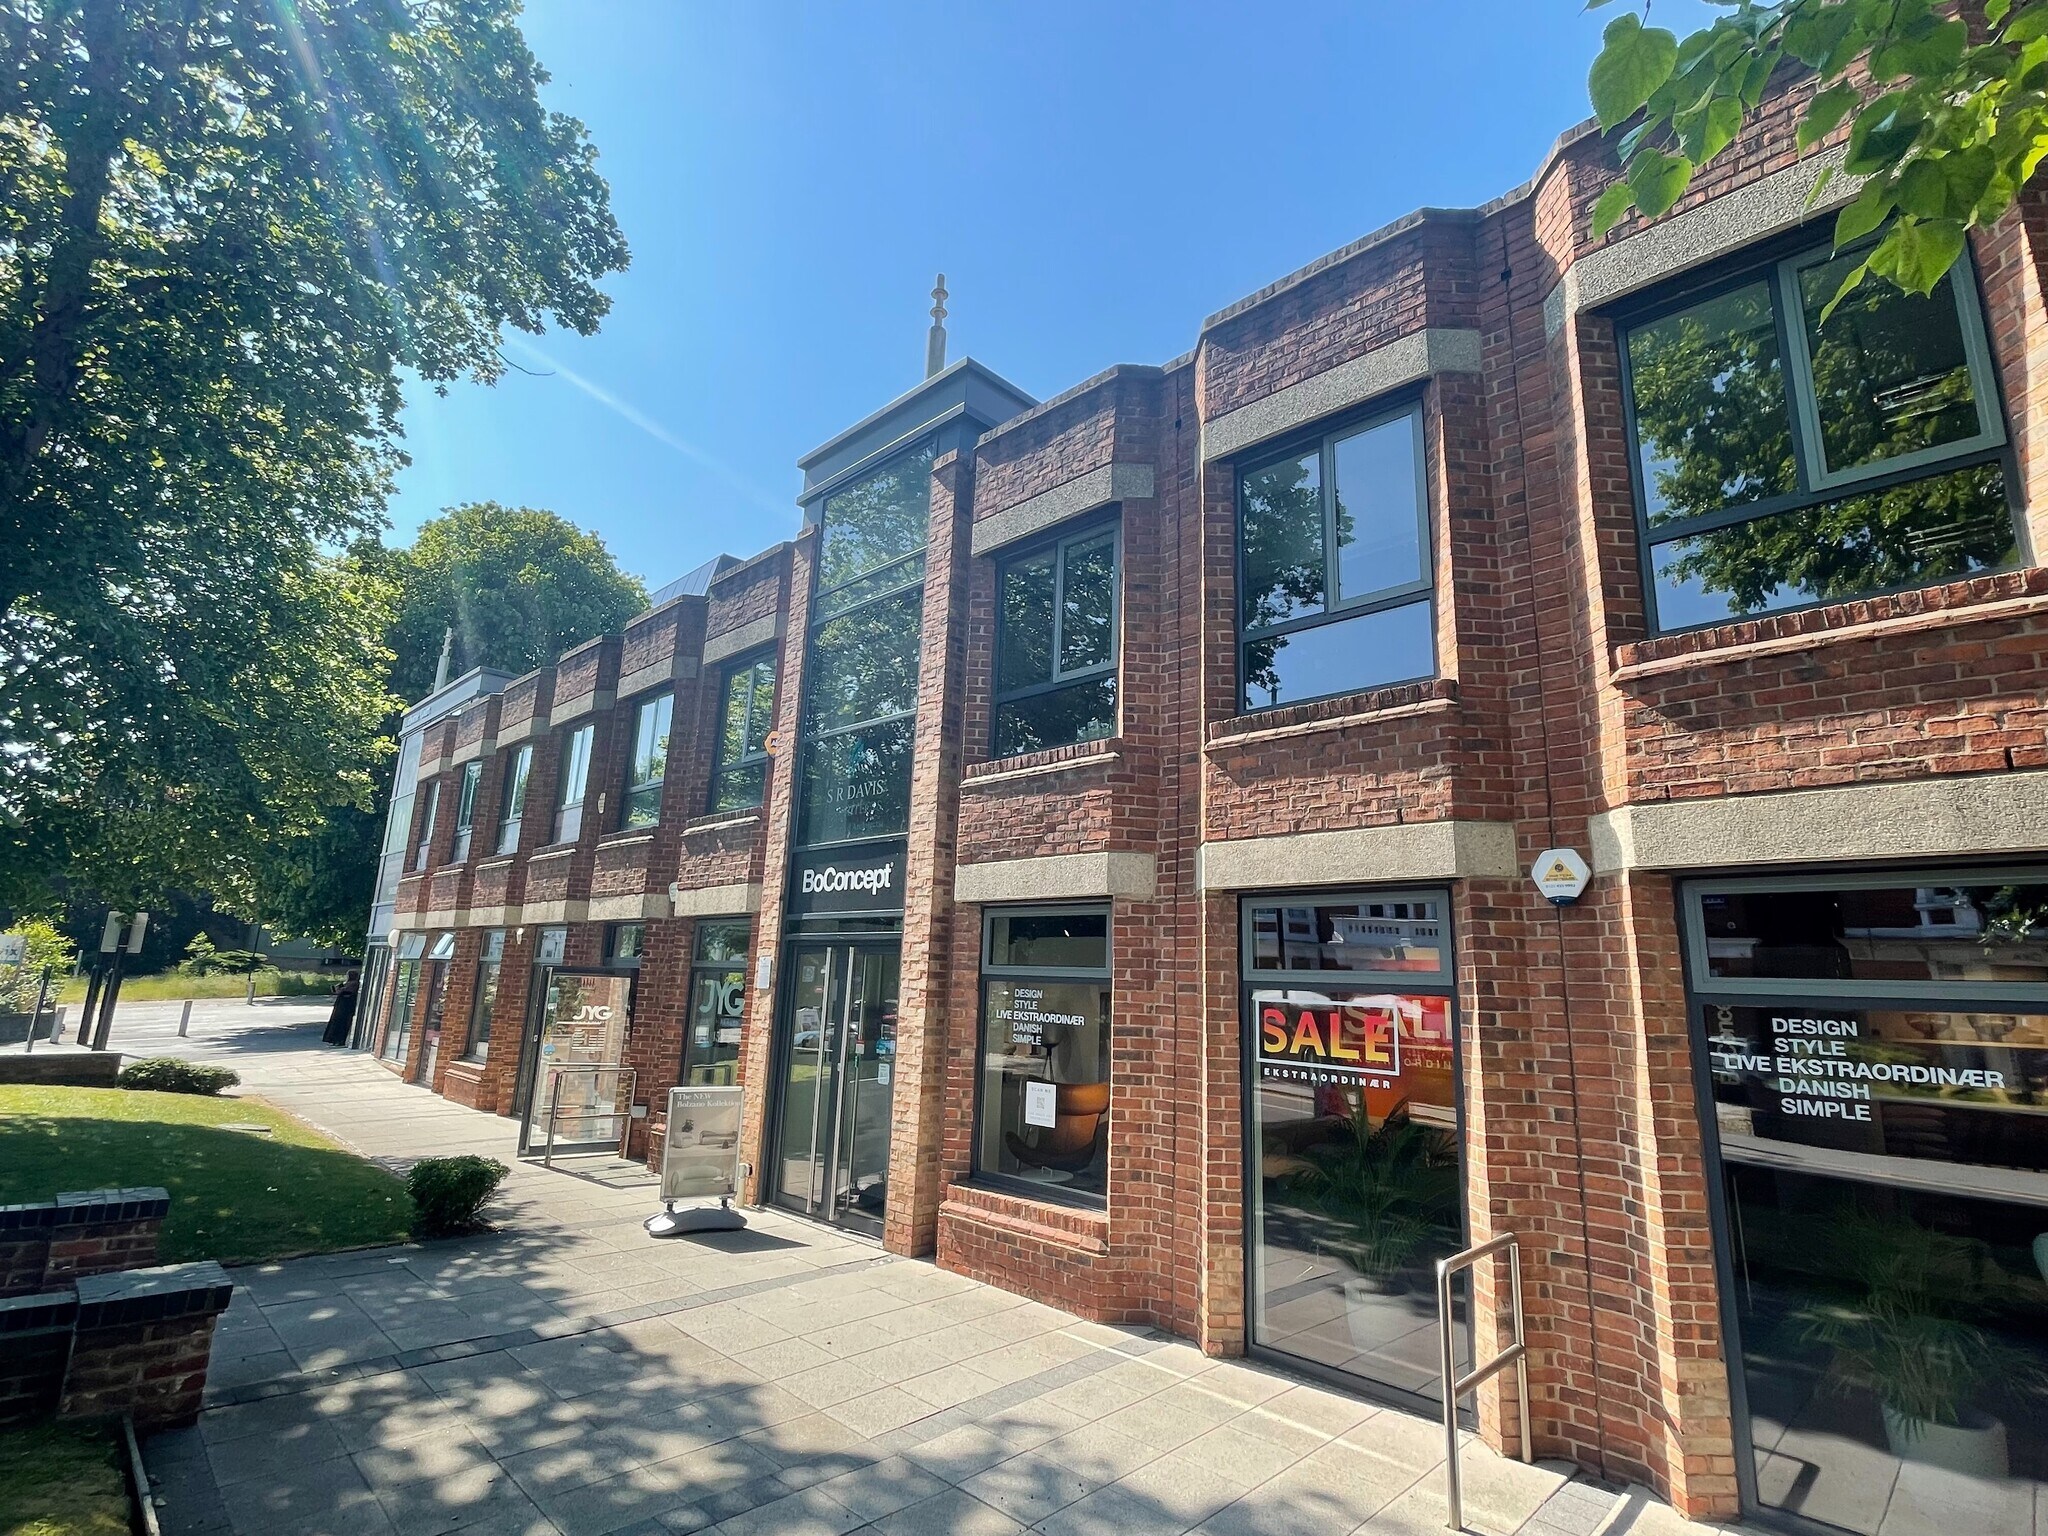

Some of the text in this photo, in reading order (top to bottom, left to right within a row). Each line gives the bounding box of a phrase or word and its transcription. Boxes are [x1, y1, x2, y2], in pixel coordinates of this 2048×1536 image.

[847, 779, 885, 800] DAVIS
[802, 862, 893, 896] BoConcept
[699, 979, 745, 1017] JYG
[1014, 988, 1043, 999] DESIGN
[572, 1005, 613, 1020] JYG
[1014, 1000, 1038, 1010] STYLE
[996, 1009, 1085, 1026] LIVE EKSTRAORDINÆR
[1771, 1017, 1858, 1037] DESIGN
[1013, 1022, 1043, 1034] DANISH
[1263, 1008, 1390, 1062] SALE
[1012, 1034, 1042, 1046] SIMPLE
[1773, 1038, 1847, 1057] STYLE
[1264, 1067, 1391, 1089] EKSTRAORDINÆR
[1723, 1054, 2006, 1089] LIVE EKSTRAORDINÆR
[1778, 1077, 1871, 1100] DANISH
[1780, 1098, 1872, 1122] SIMPLE
